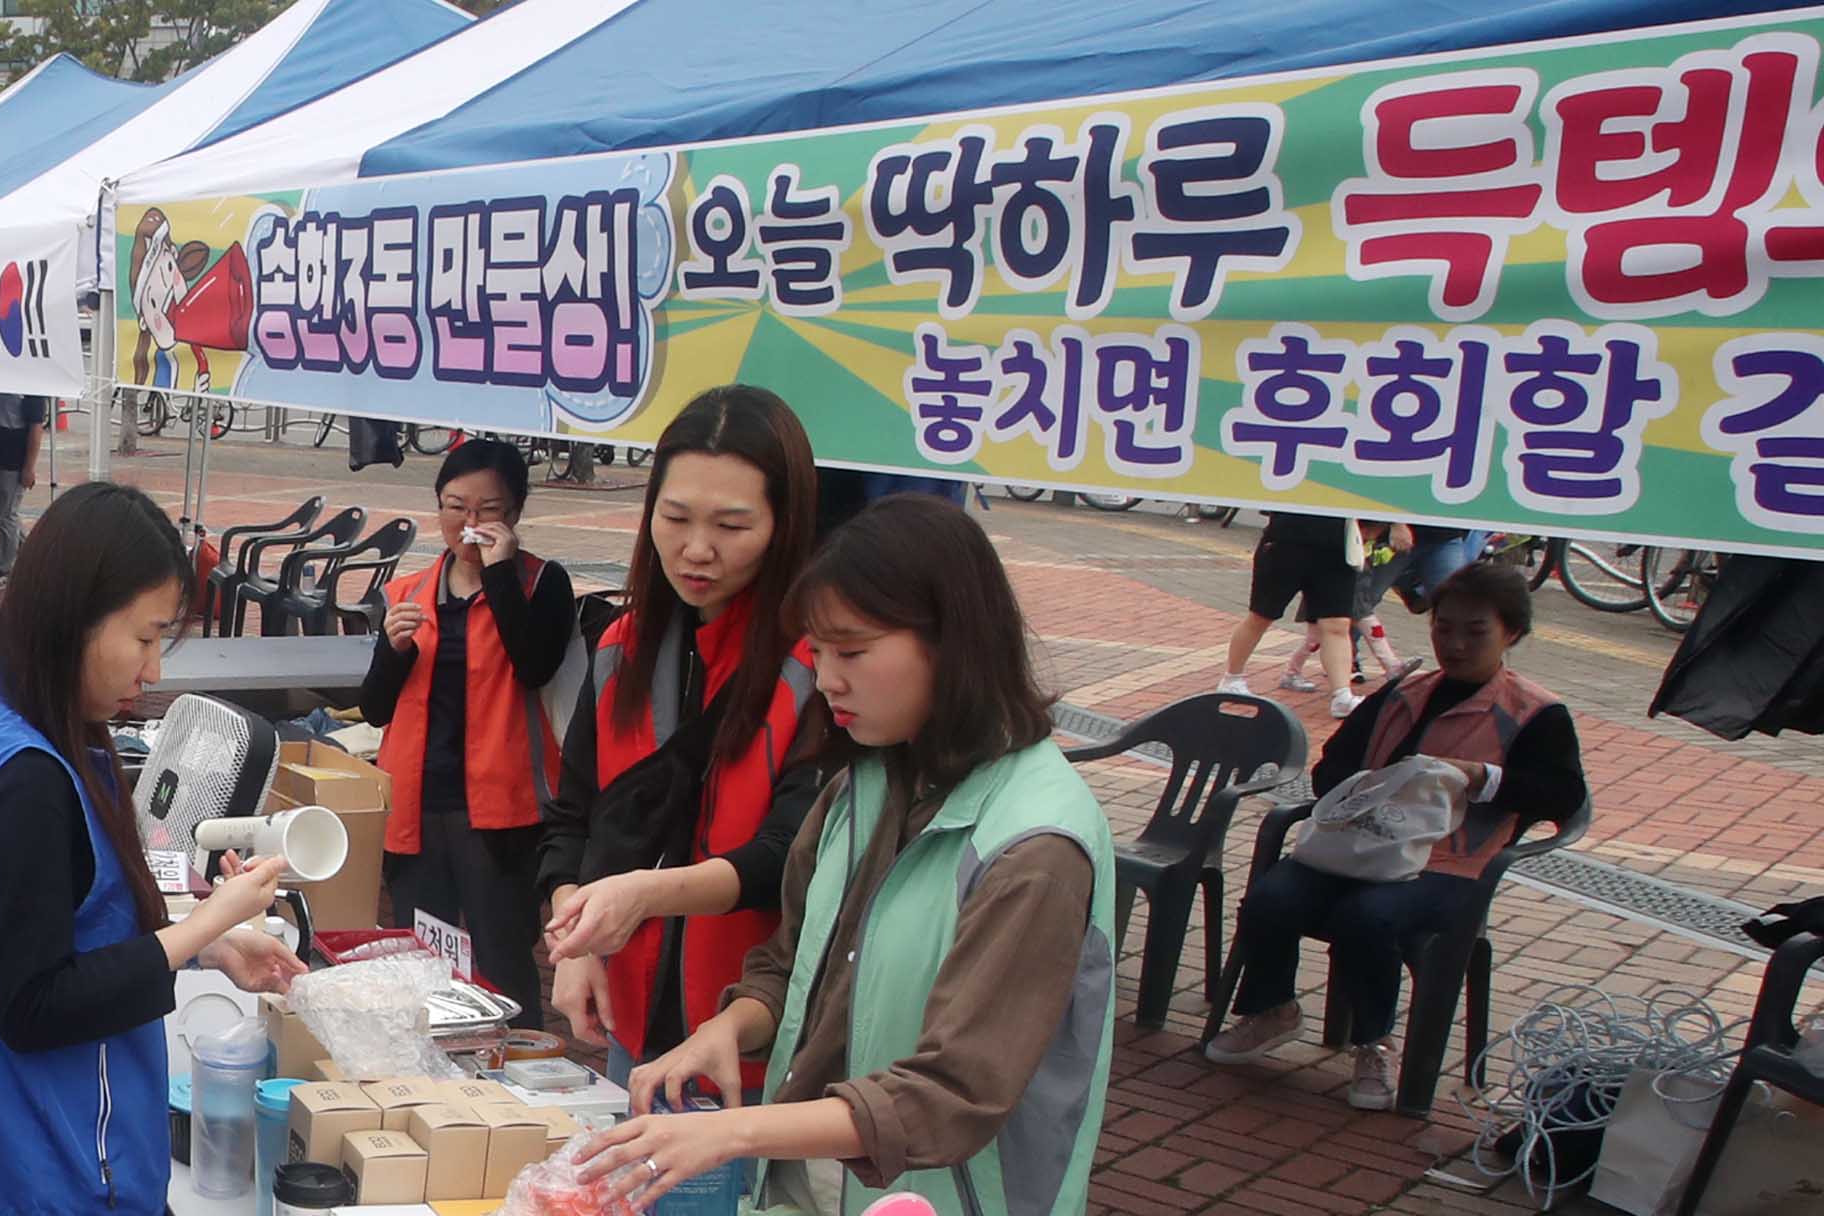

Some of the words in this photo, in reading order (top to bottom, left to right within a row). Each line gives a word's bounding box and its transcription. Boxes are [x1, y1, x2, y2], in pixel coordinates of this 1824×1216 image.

[255, 207, 423, 382] 송현3동
[428, 187, 641, 398] 만물상!
[685, 174, 846, 304] 오늘
[869, 117, 1292, 311] 딱하루
[914, 333, 1191, 465] 놓치면
[1230, 335, 1663, 499] 후회할
